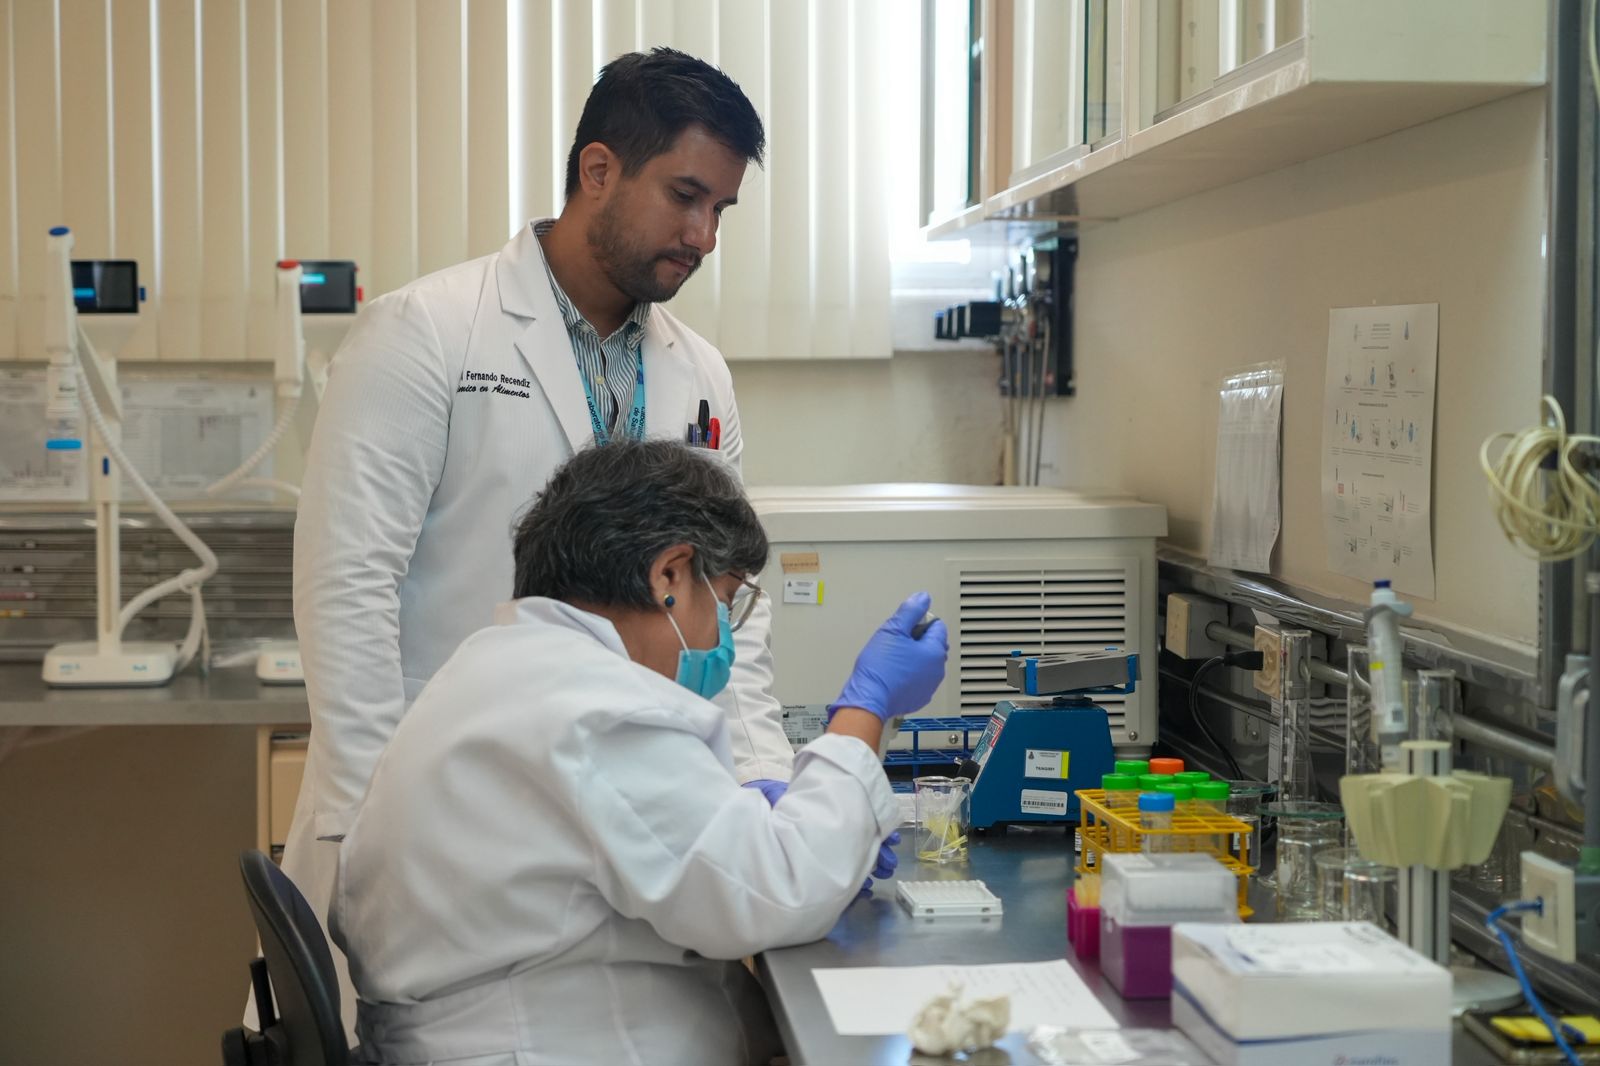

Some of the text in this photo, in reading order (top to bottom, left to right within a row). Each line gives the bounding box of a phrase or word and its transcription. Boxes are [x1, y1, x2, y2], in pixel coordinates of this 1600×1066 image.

[466, 370, 498, 382] Fernando
[500, 374, 531, 388] Recendiz
[479, 385, 489, 393] en
[491, 383, 530, 399] Alimentos
